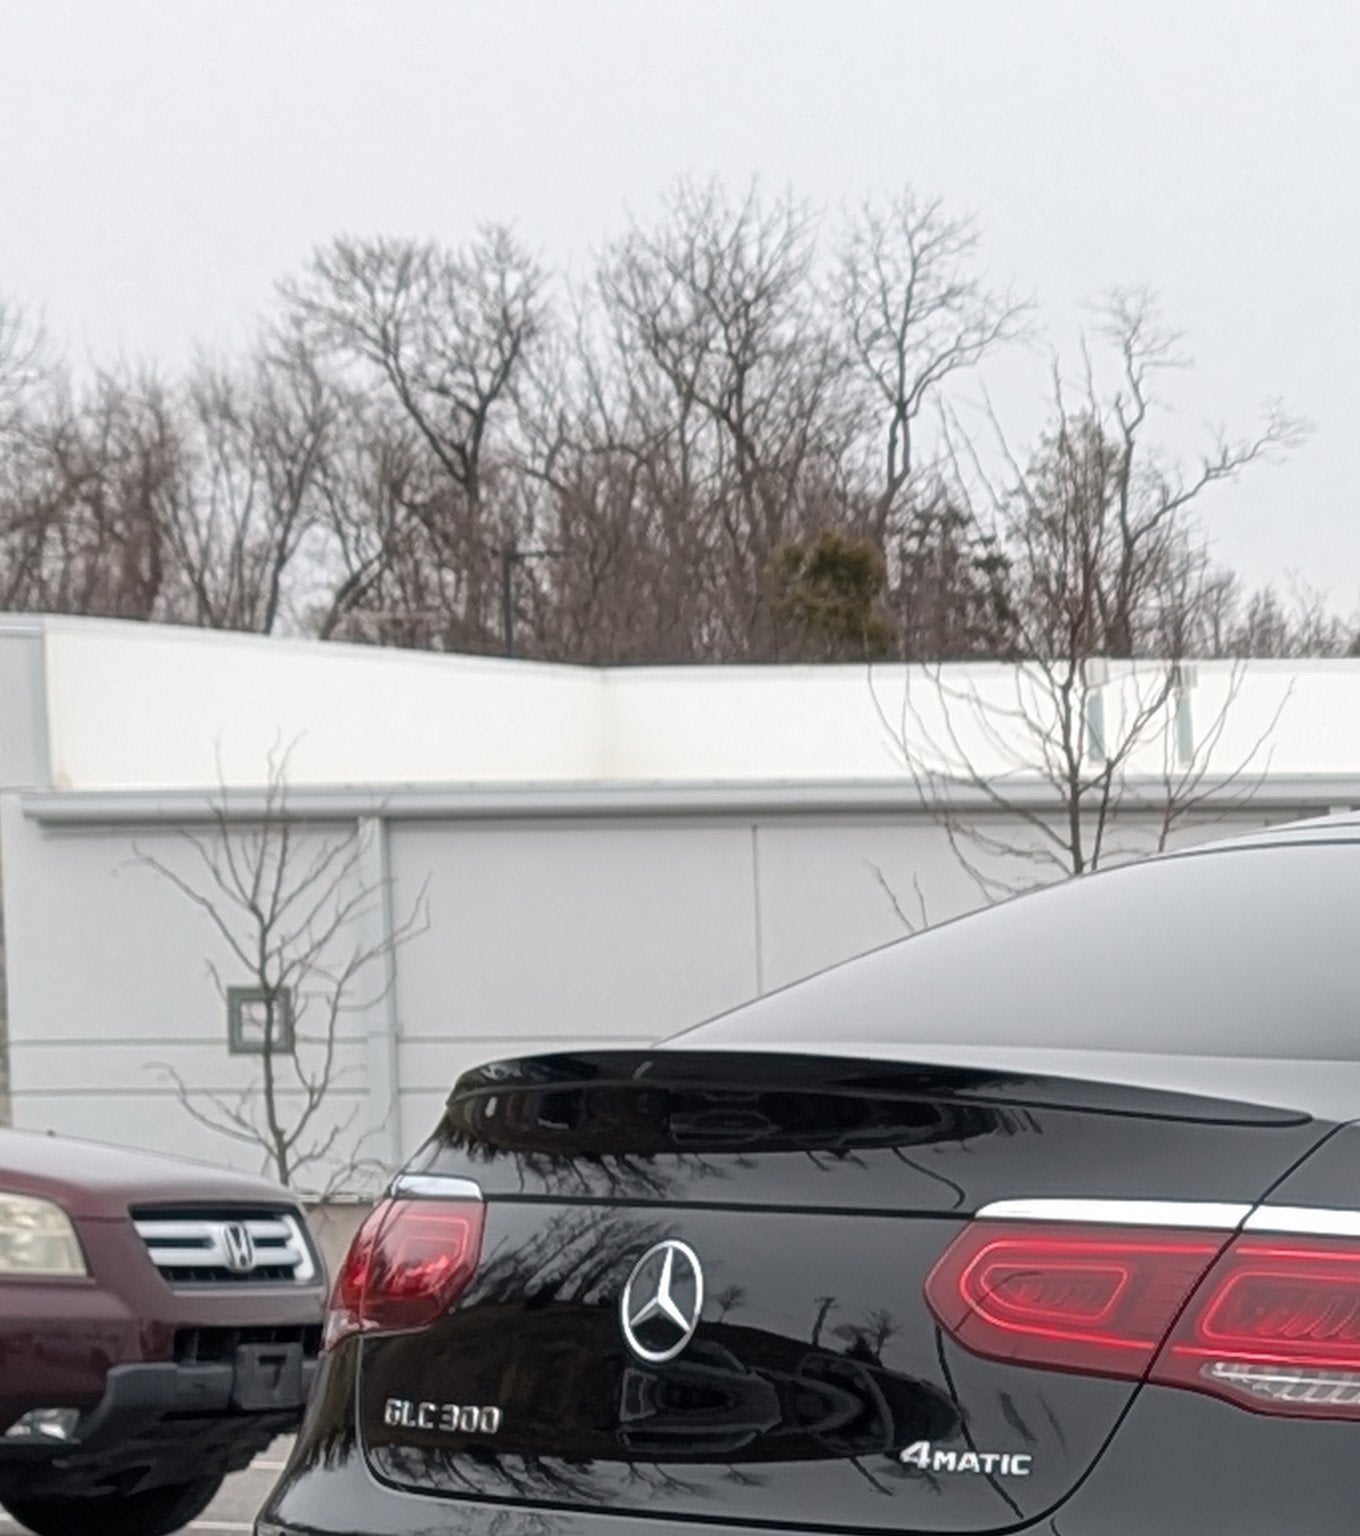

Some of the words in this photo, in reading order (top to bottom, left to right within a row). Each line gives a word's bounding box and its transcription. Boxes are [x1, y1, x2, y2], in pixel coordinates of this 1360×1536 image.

[384, 1398, 437, 1430] GLC
[439, 1403, 501, 1434] 300
[900, 1440, 1032, 1475] 4MATIC
